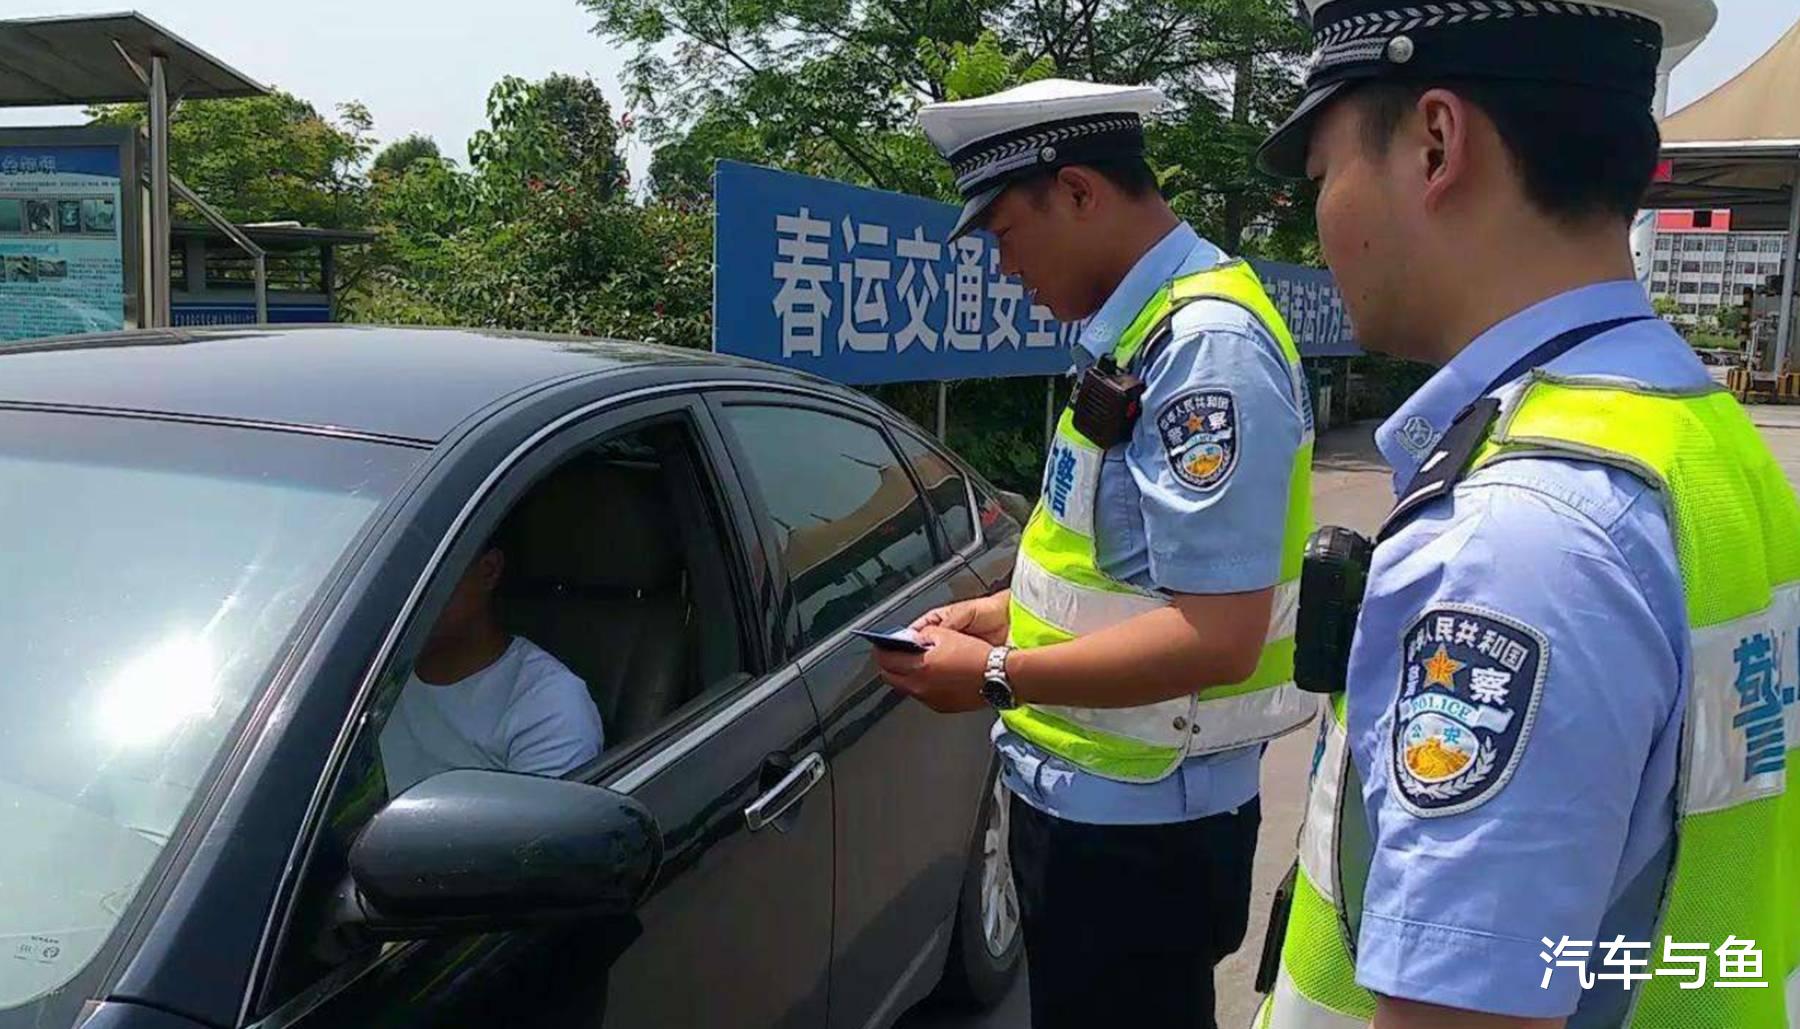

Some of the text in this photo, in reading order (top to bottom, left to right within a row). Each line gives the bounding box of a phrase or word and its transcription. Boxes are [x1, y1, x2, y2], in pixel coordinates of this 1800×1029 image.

[772, 206, 1093, 358] 春运交通安
[1407, 616, 1529, 673] 中华人民共和国
[1410, 695, 1473, 720] POLICE
